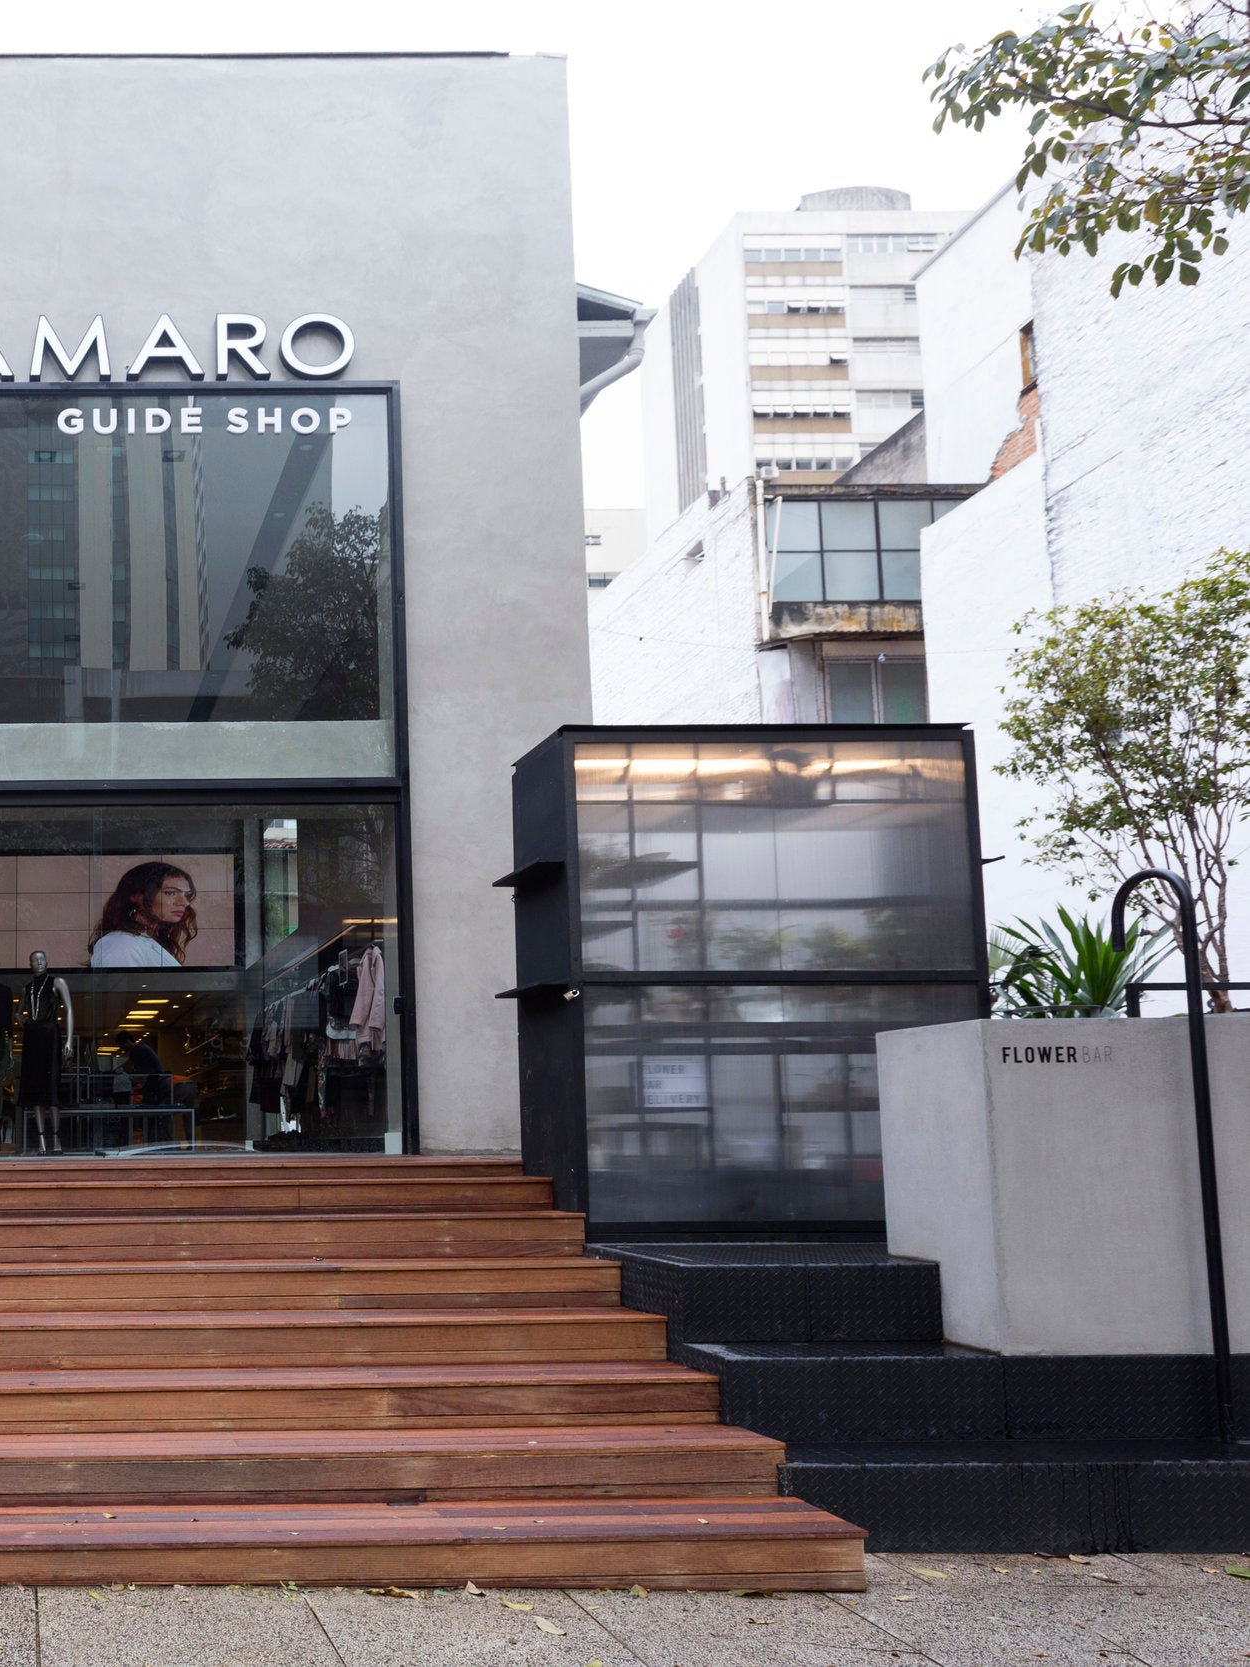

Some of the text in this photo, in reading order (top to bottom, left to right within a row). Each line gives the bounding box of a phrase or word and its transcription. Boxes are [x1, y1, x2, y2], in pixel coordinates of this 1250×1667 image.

[56, 406, 353, 435] GUIDE SHOP
[1002, 1046, 1078, 1063] FLOWER
[645, 1094, 702, 1105] ELIVERY
